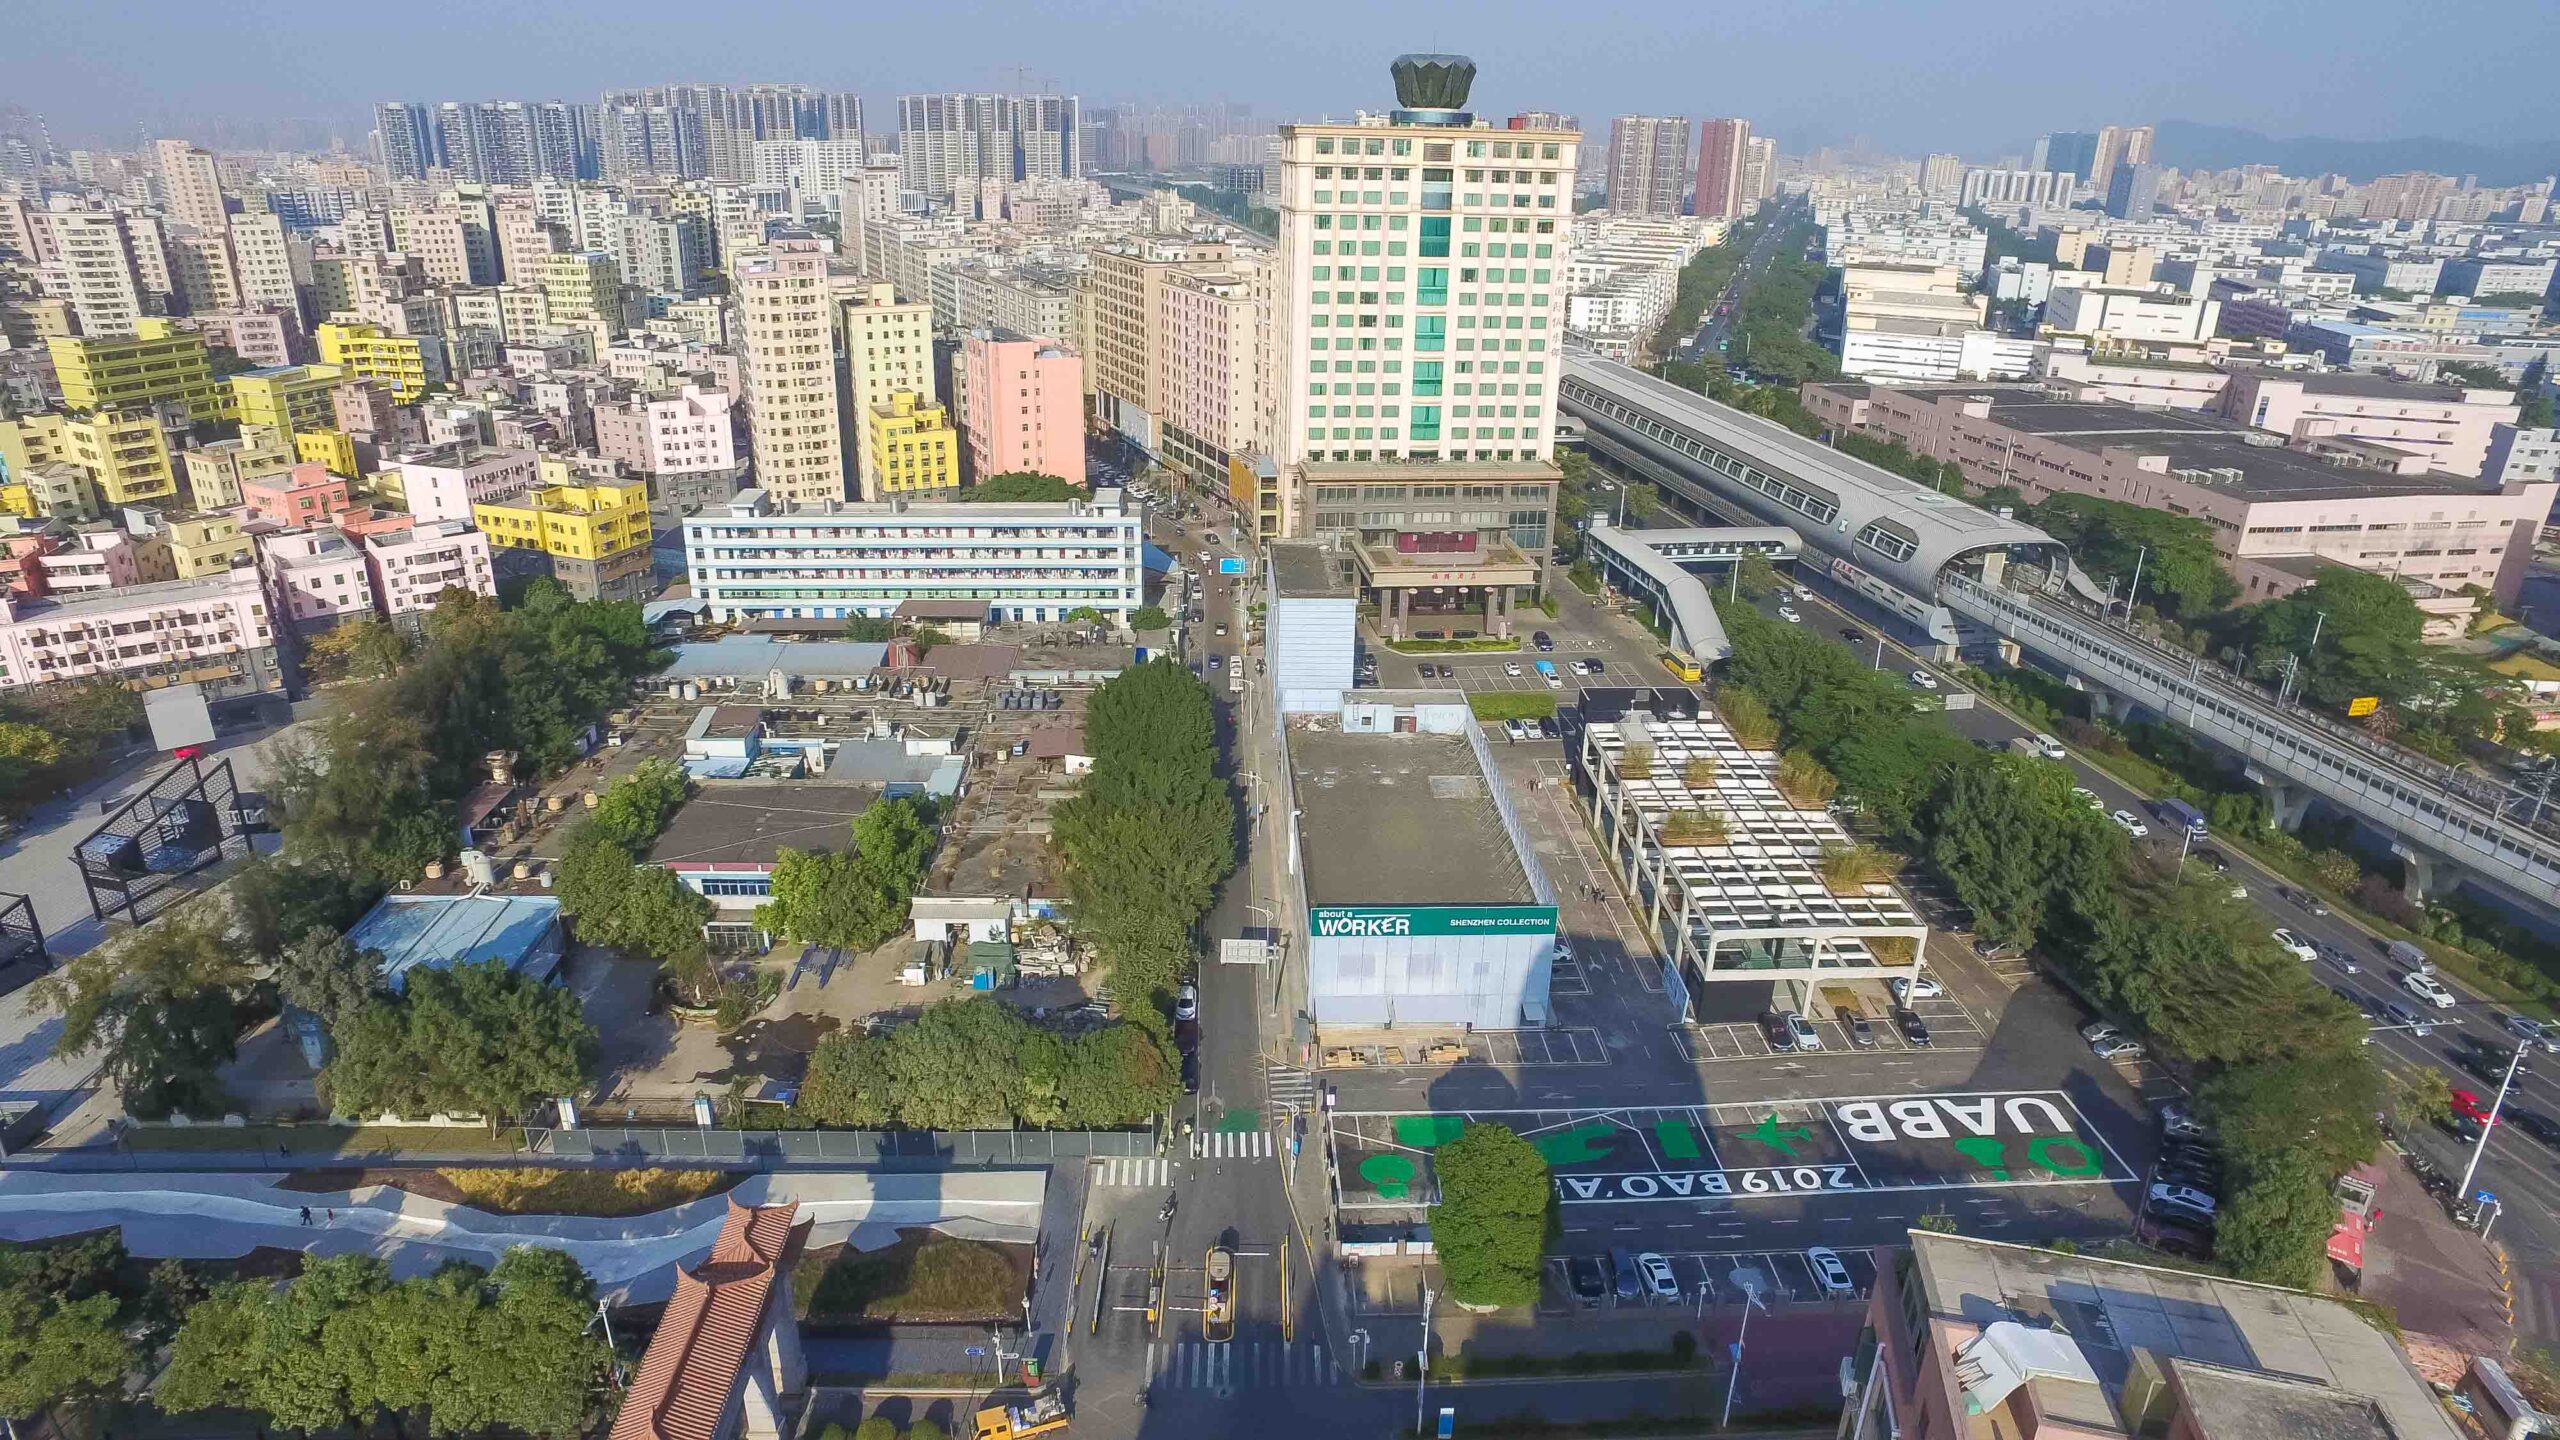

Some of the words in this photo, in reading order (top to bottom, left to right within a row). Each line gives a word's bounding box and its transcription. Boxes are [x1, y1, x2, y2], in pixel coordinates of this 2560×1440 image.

[1318, 910, 1345, 918] about
[1496, 918, 1550, 926] COLLECTION
[1318, 917, 1410, 936] WORKER
[1836, 1097, 2073, 1142] UABB
[1741, 1167, 1855, 1193] 2019
